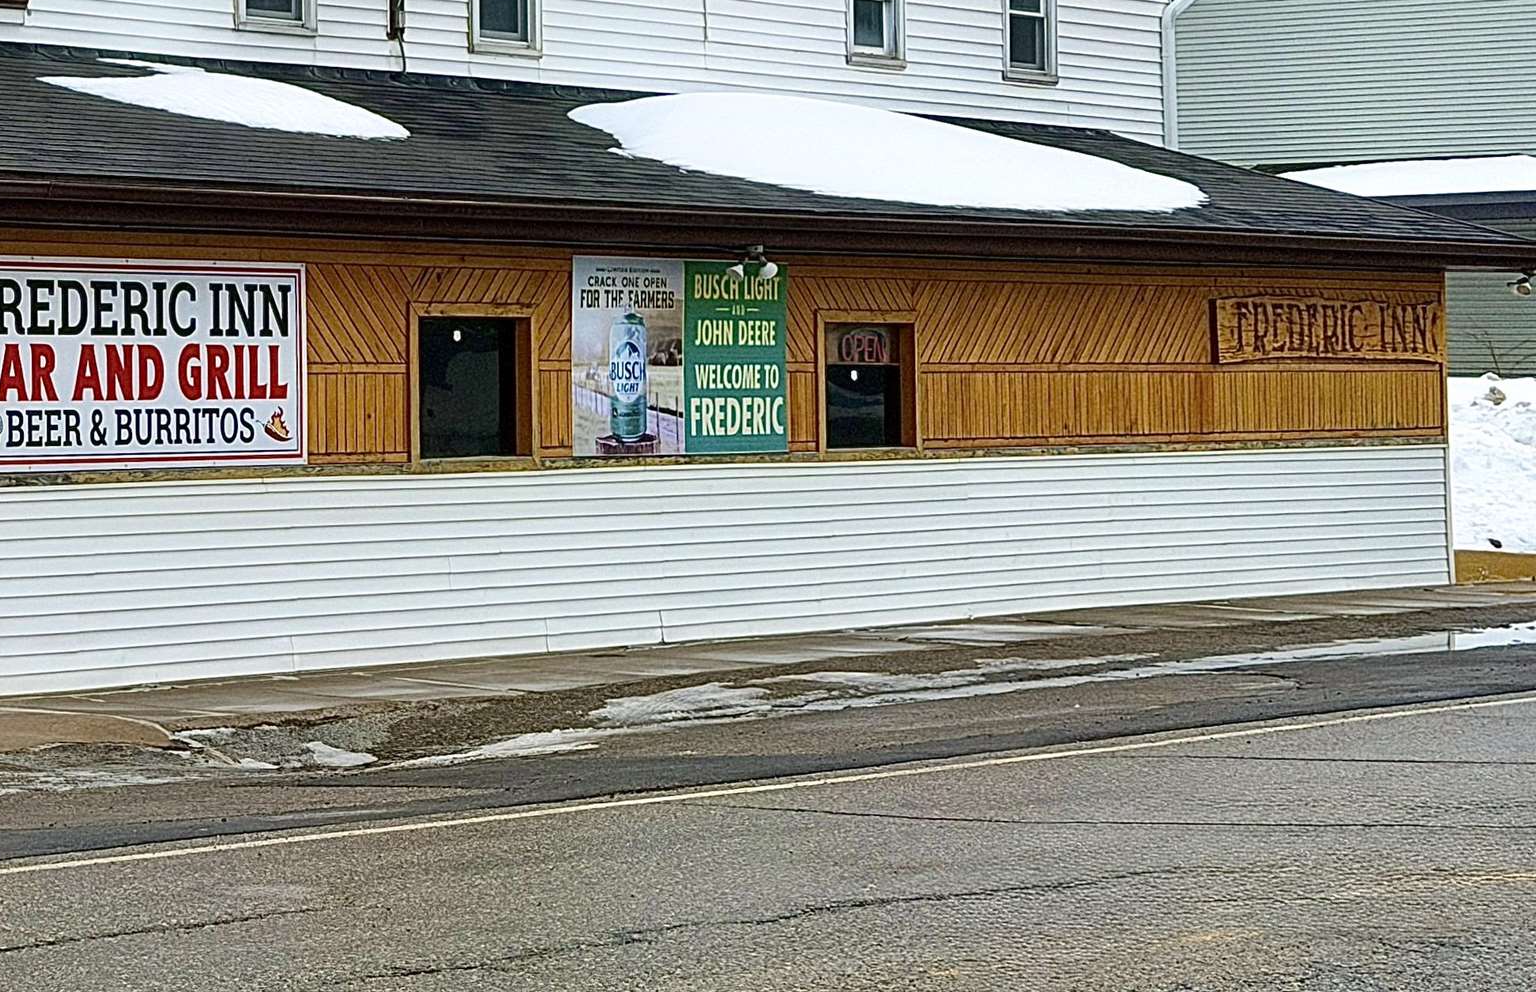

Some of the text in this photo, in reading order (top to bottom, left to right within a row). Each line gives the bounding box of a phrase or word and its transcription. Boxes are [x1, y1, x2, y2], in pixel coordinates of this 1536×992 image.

[587, 276, 667, 288] CRACK ONE OPEN
[694, 274, 780, 300] BUSCH LIGHT
[209, 283, 292, 337] INN
[580, 289, 675, 308] FOR THE FARMERS
[695, 320, 776, 346] JOHN DEERE
[1236, 302, 1430, 354] FREDERIC INN
[842, 335, 890, 363] OPEN
[72, 343, 165, 401] AND
[178, 343, 289, 400] GRILL
[609, 361, 646, 381] BUSCH
[694, 364, 780, 390] WELCOME TO
[616, 383, 640, 393] LIGHT
[5, 407, 256, 448] BEER & BURRITOS
[690, 396, 784, 436] FREDERIC
